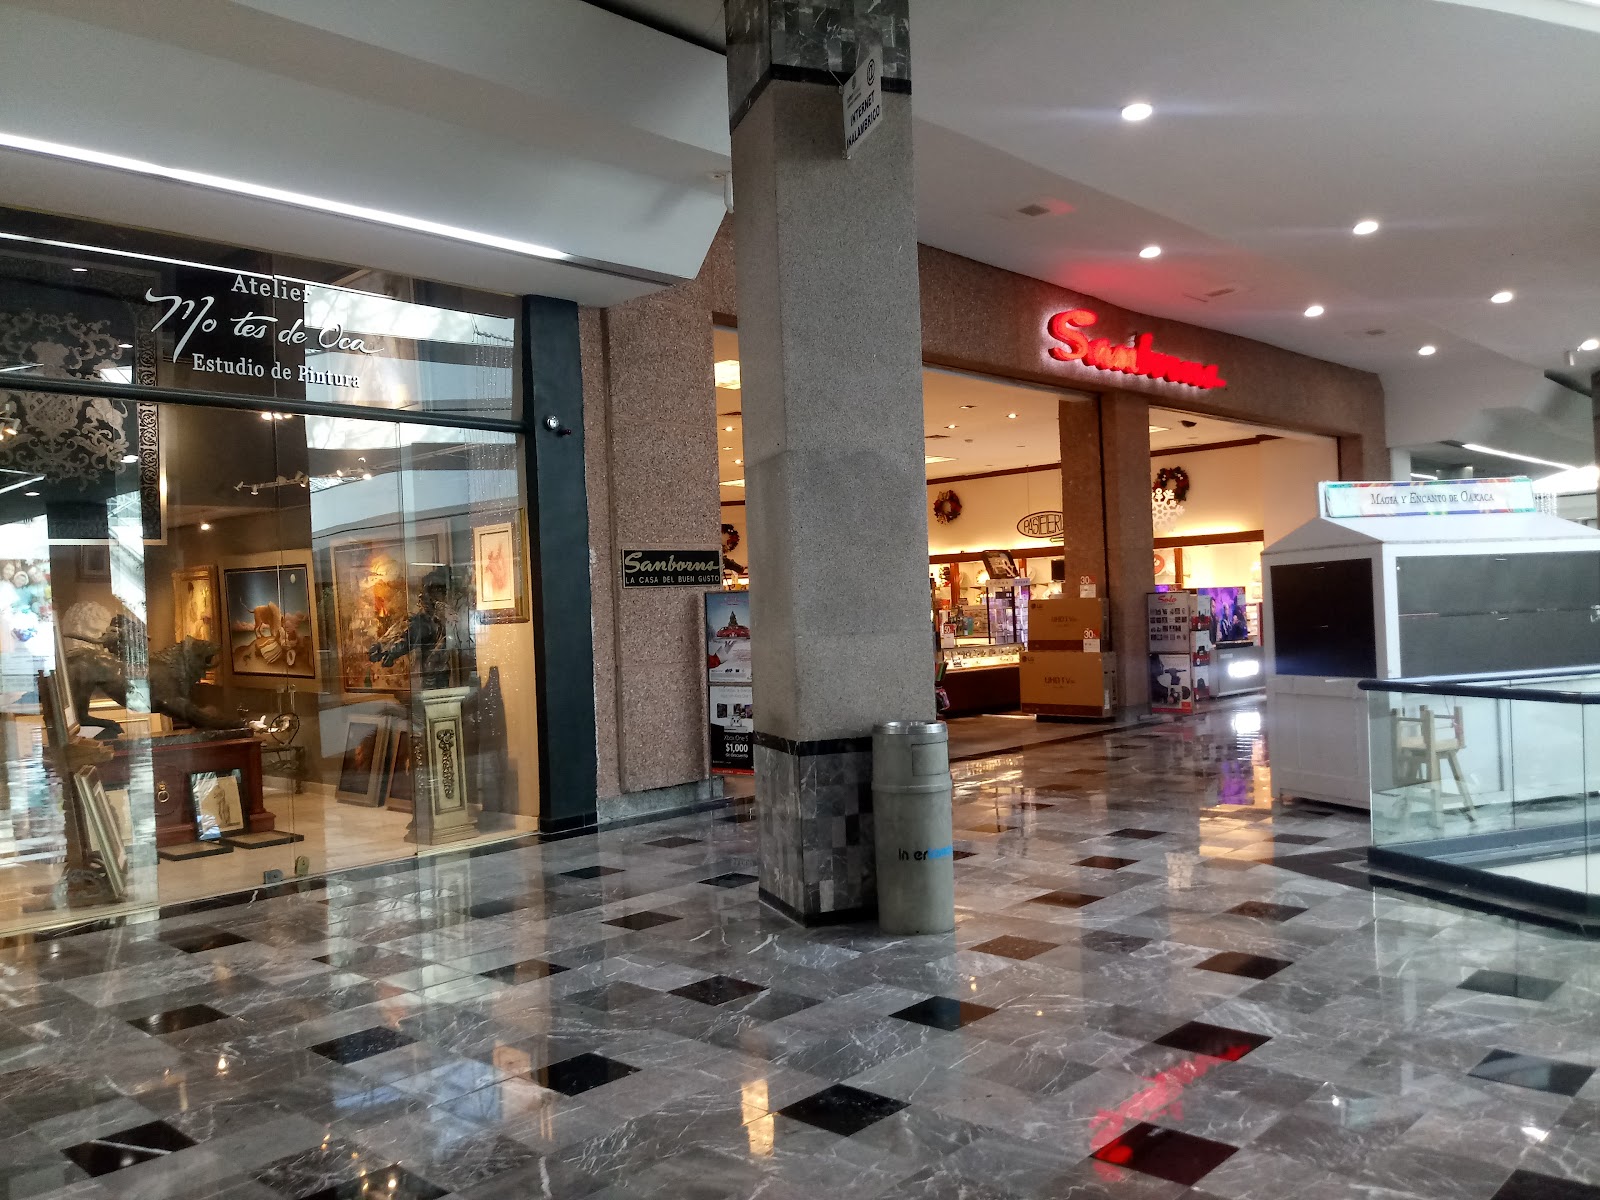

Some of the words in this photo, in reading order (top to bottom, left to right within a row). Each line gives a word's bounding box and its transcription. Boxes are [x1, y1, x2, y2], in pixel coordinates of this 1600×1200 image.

[851, 90, 875, 127] INTERNET
[230, 275, 312, 303] Atelier
[278, 319, 309, 345] de
[318, 323, 384, 354] Oca
[192, 353, 265, 378] Estudio
[270, 361, 292, 380] de
[297, 364, 361, 389] Pintura
[624, 551, 720, 574] Sanborns
[625, 576, 635, 584] LA
[638, 576, 659, 584] CASA
[662, 576, 674, 584] DEL
[677, 575, 695, 583] BUEN
[697, 575, 720, 583] GUSTO
[725, 742, 749, 753] $1,000
